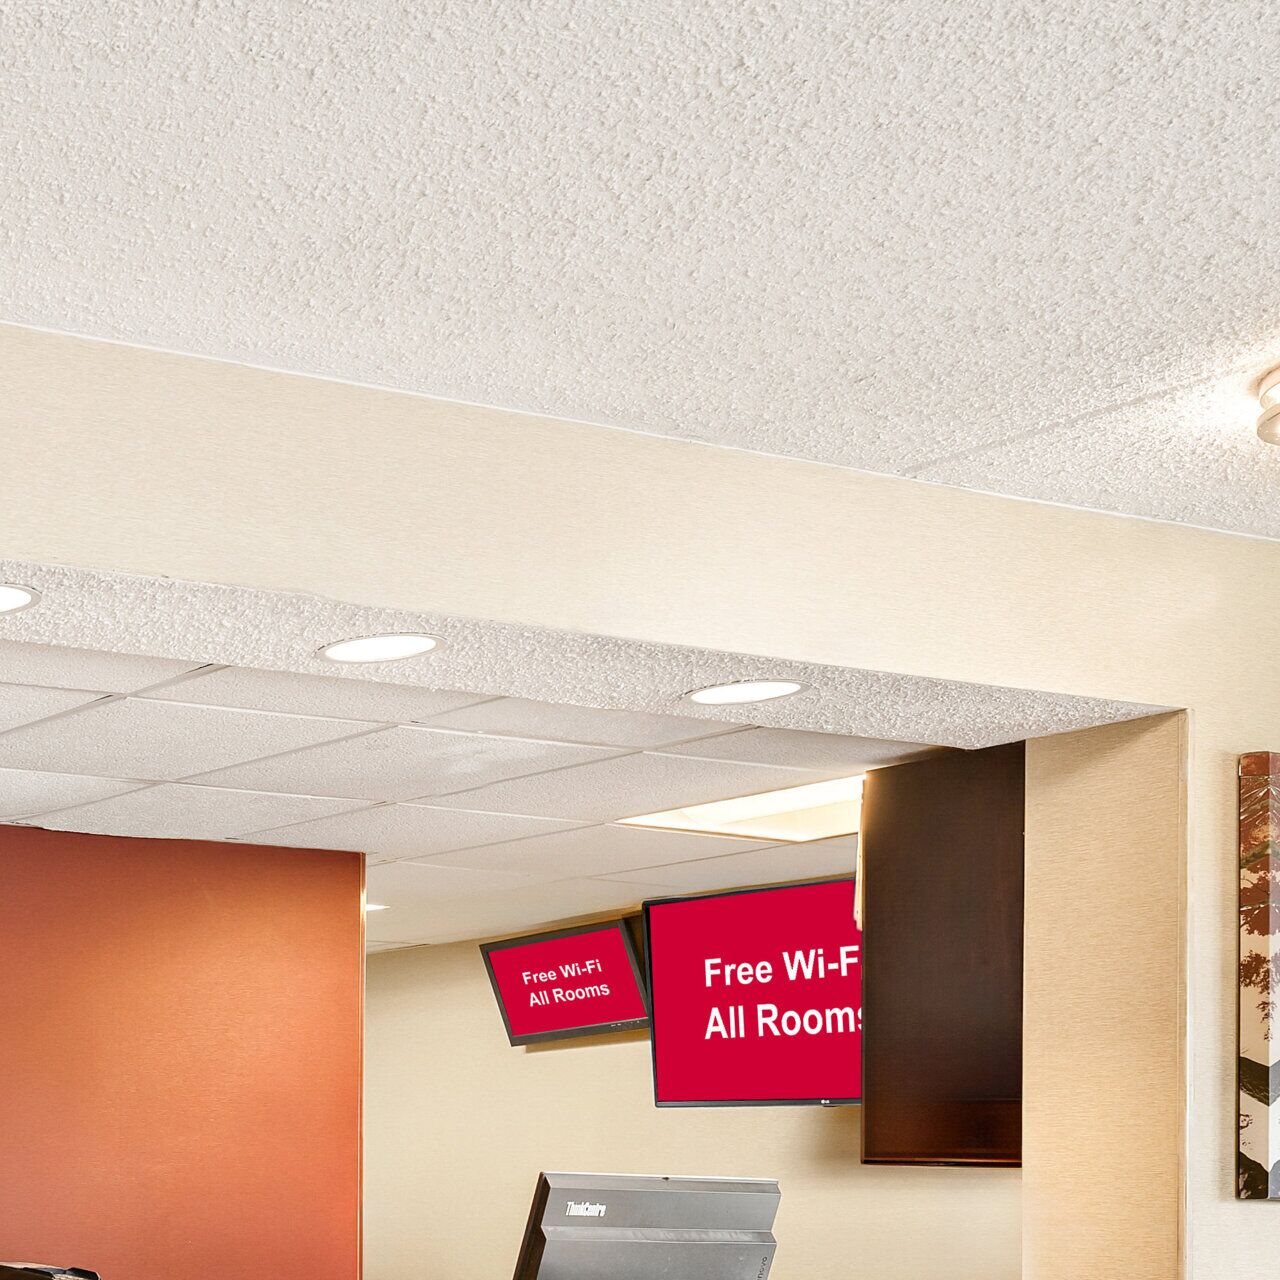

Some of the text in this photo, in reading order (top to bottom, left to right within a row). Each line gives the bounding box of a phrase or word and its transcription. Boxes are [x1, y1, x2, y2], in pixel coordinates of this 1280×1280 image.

[521, 958, 602, 985] Free Wi-Fi
[704, 944, 860, 988] Free Wi-F
[529, 983, 610, 1007] All Rooms
[704, 1005, 745, 1040] All
